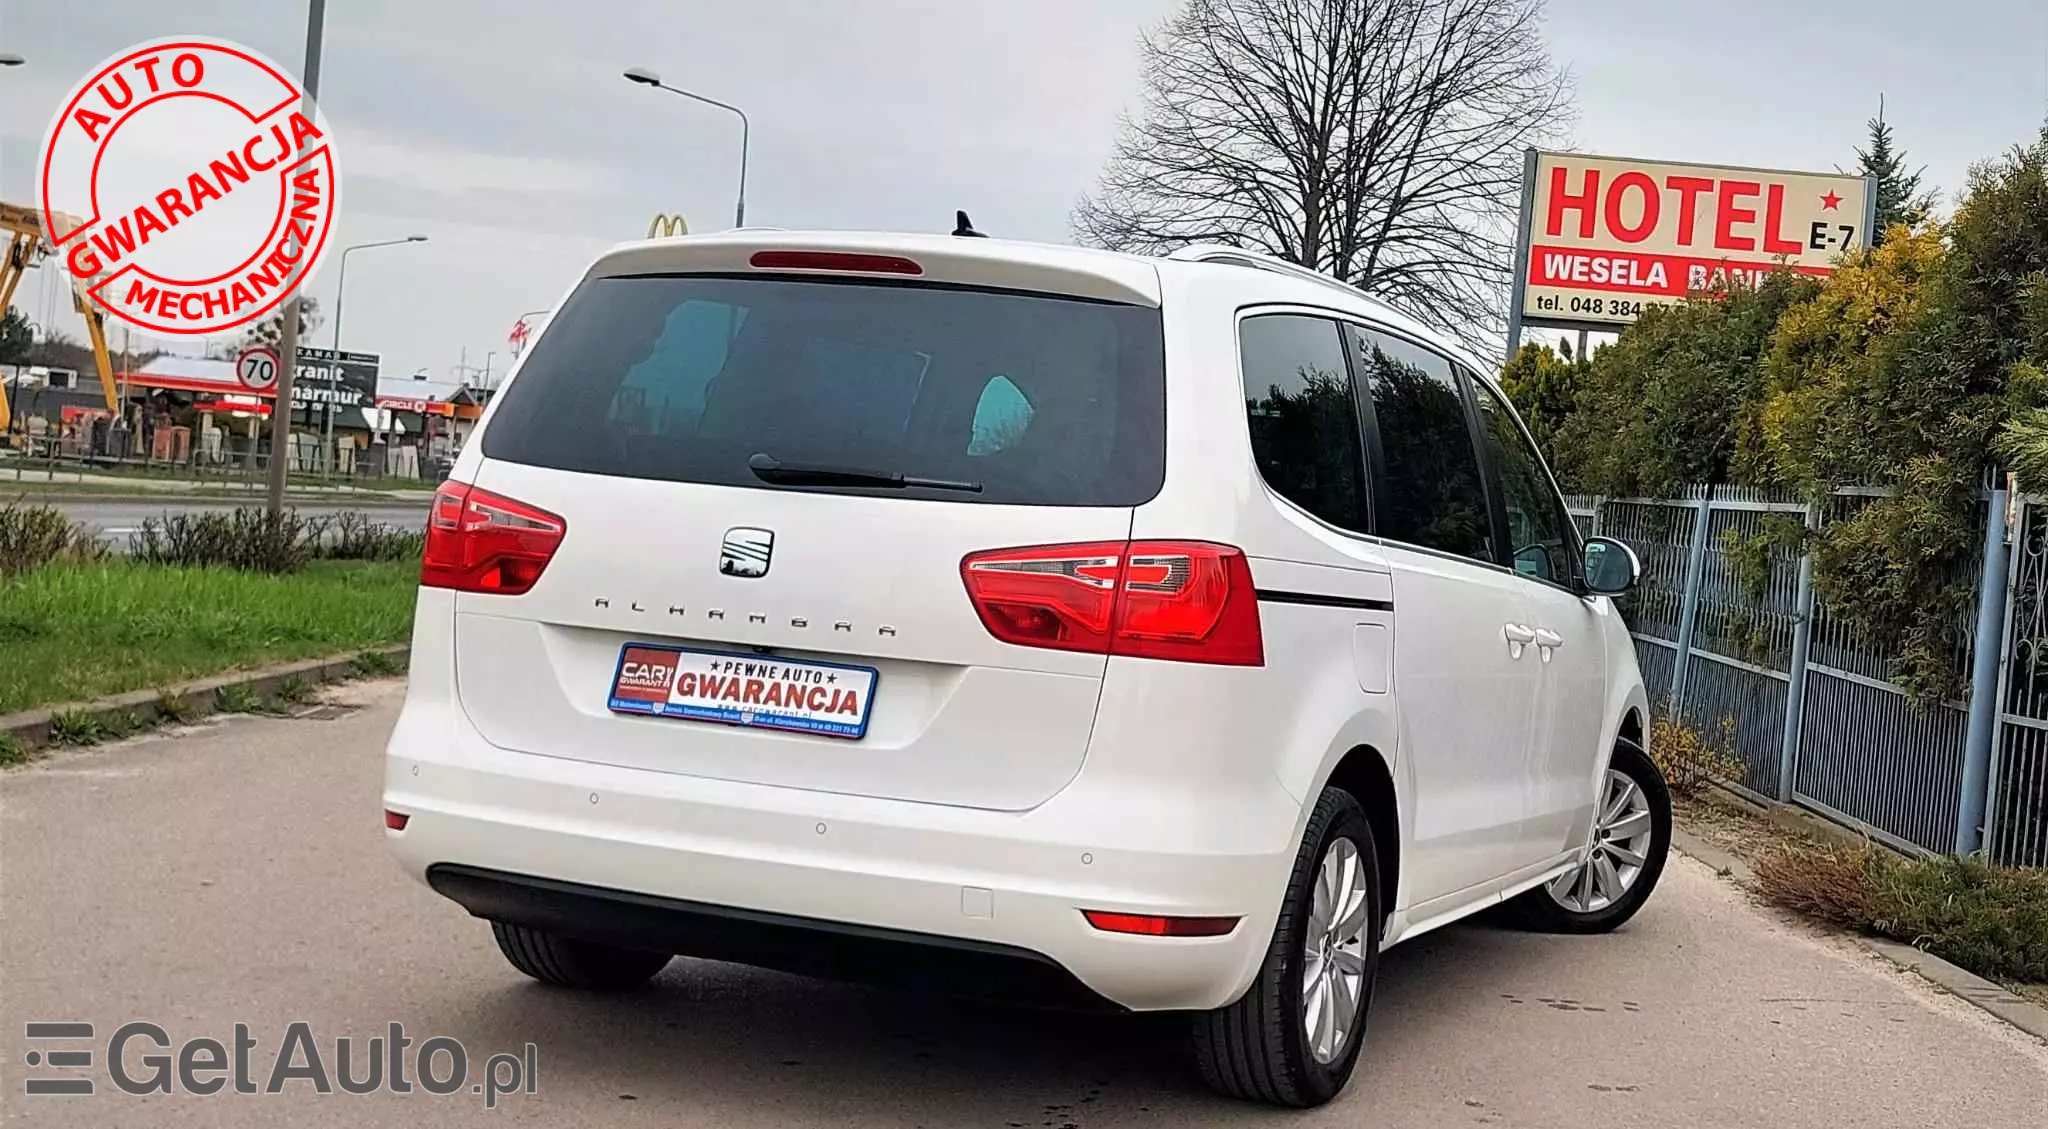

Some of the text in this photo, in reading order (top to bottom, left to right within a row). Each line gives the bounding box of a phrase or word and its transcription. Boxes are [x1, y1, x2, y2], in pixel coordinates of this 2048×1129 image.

[1546, 166, 1803, 255] HOTEL
[1810, 221, 1854, 251] E-7
[1544, 252, 1668, 288] WESELA
[1537, 295, 1564, 312] tel.
[1570, 296, 1603, 314] 048
[1608, 300, 1640, 317] 384
[246, 358, 273, 381] 70
[594, 597, 897, 638] ALHAMBRA
[622, 662, 664, 680] CAR
[723, 661, 822, 684] PEWNE AUTO
[677, 672, 858, 716] GWARANCJA
